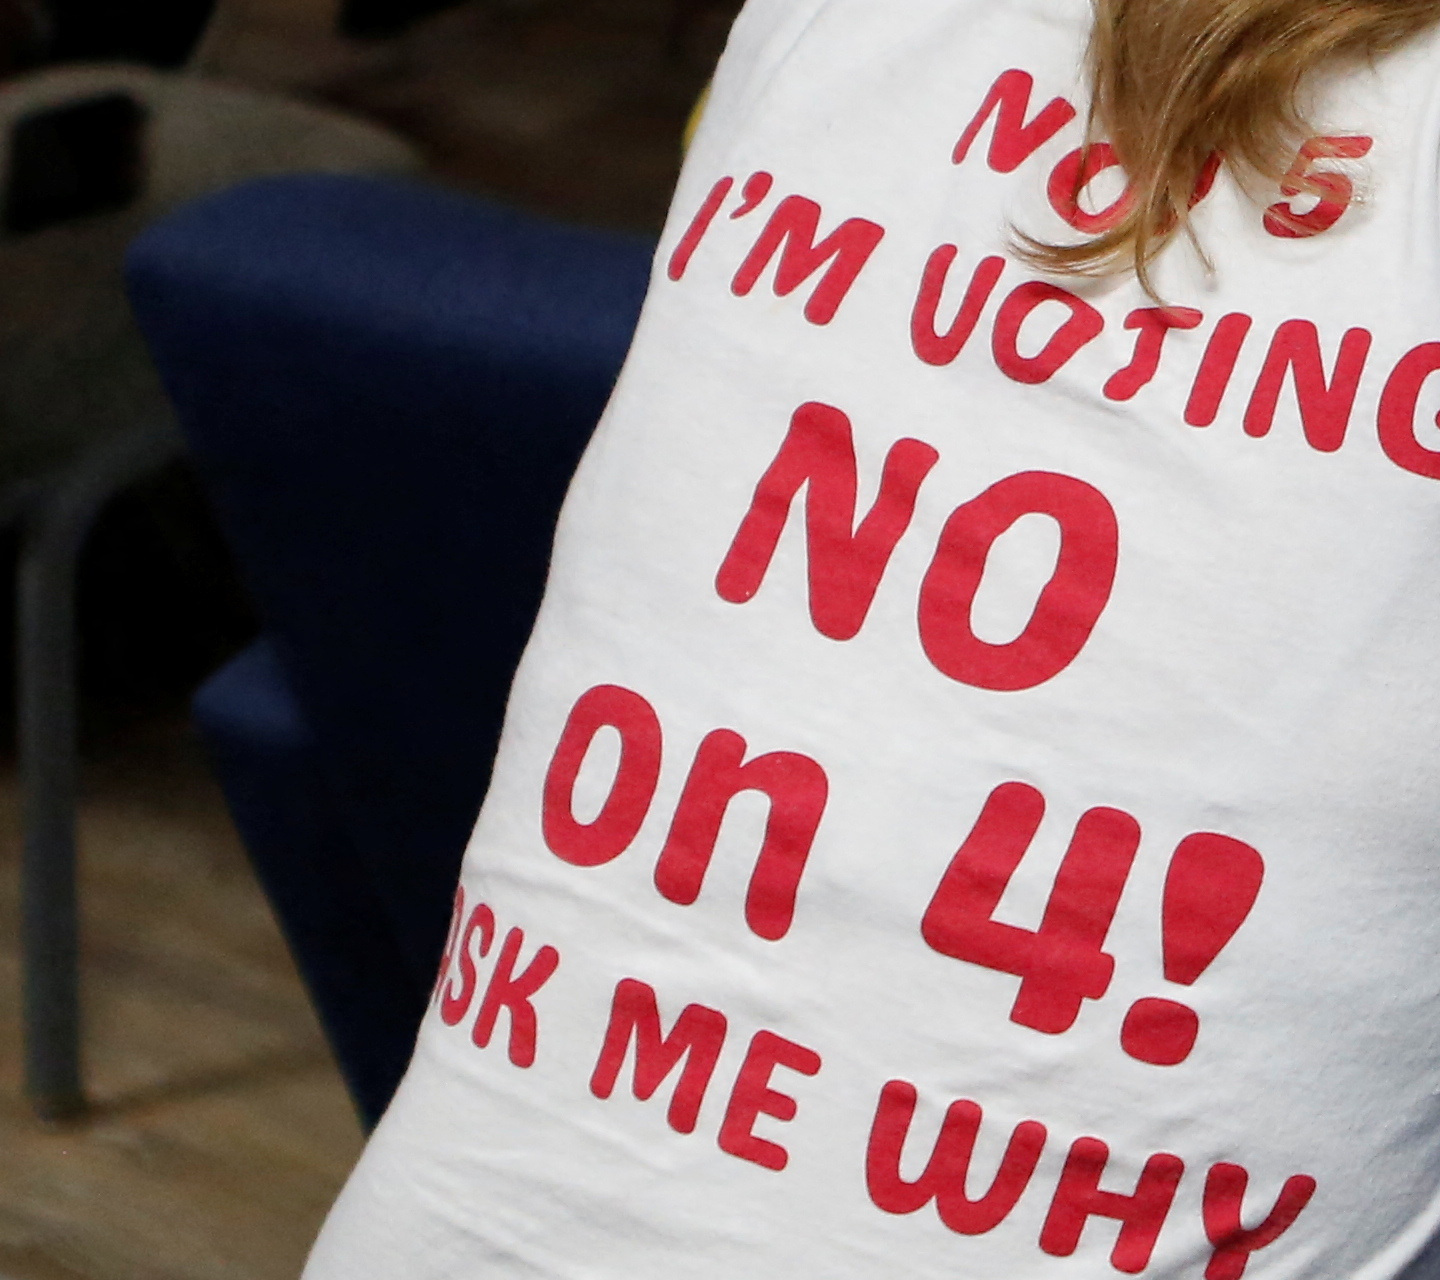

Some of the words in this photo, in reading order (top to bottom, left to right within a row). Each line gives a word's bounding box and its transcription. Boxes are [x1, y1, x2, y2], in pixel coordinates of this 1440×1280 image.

[668, 171, 886, 326] I'M
[1263, 135, 1374, 239] 5
[716, 401, 1120, 692] NO
[921, 781, 1266, 1067] 4!
[590, 978, 823, 1172] ME
